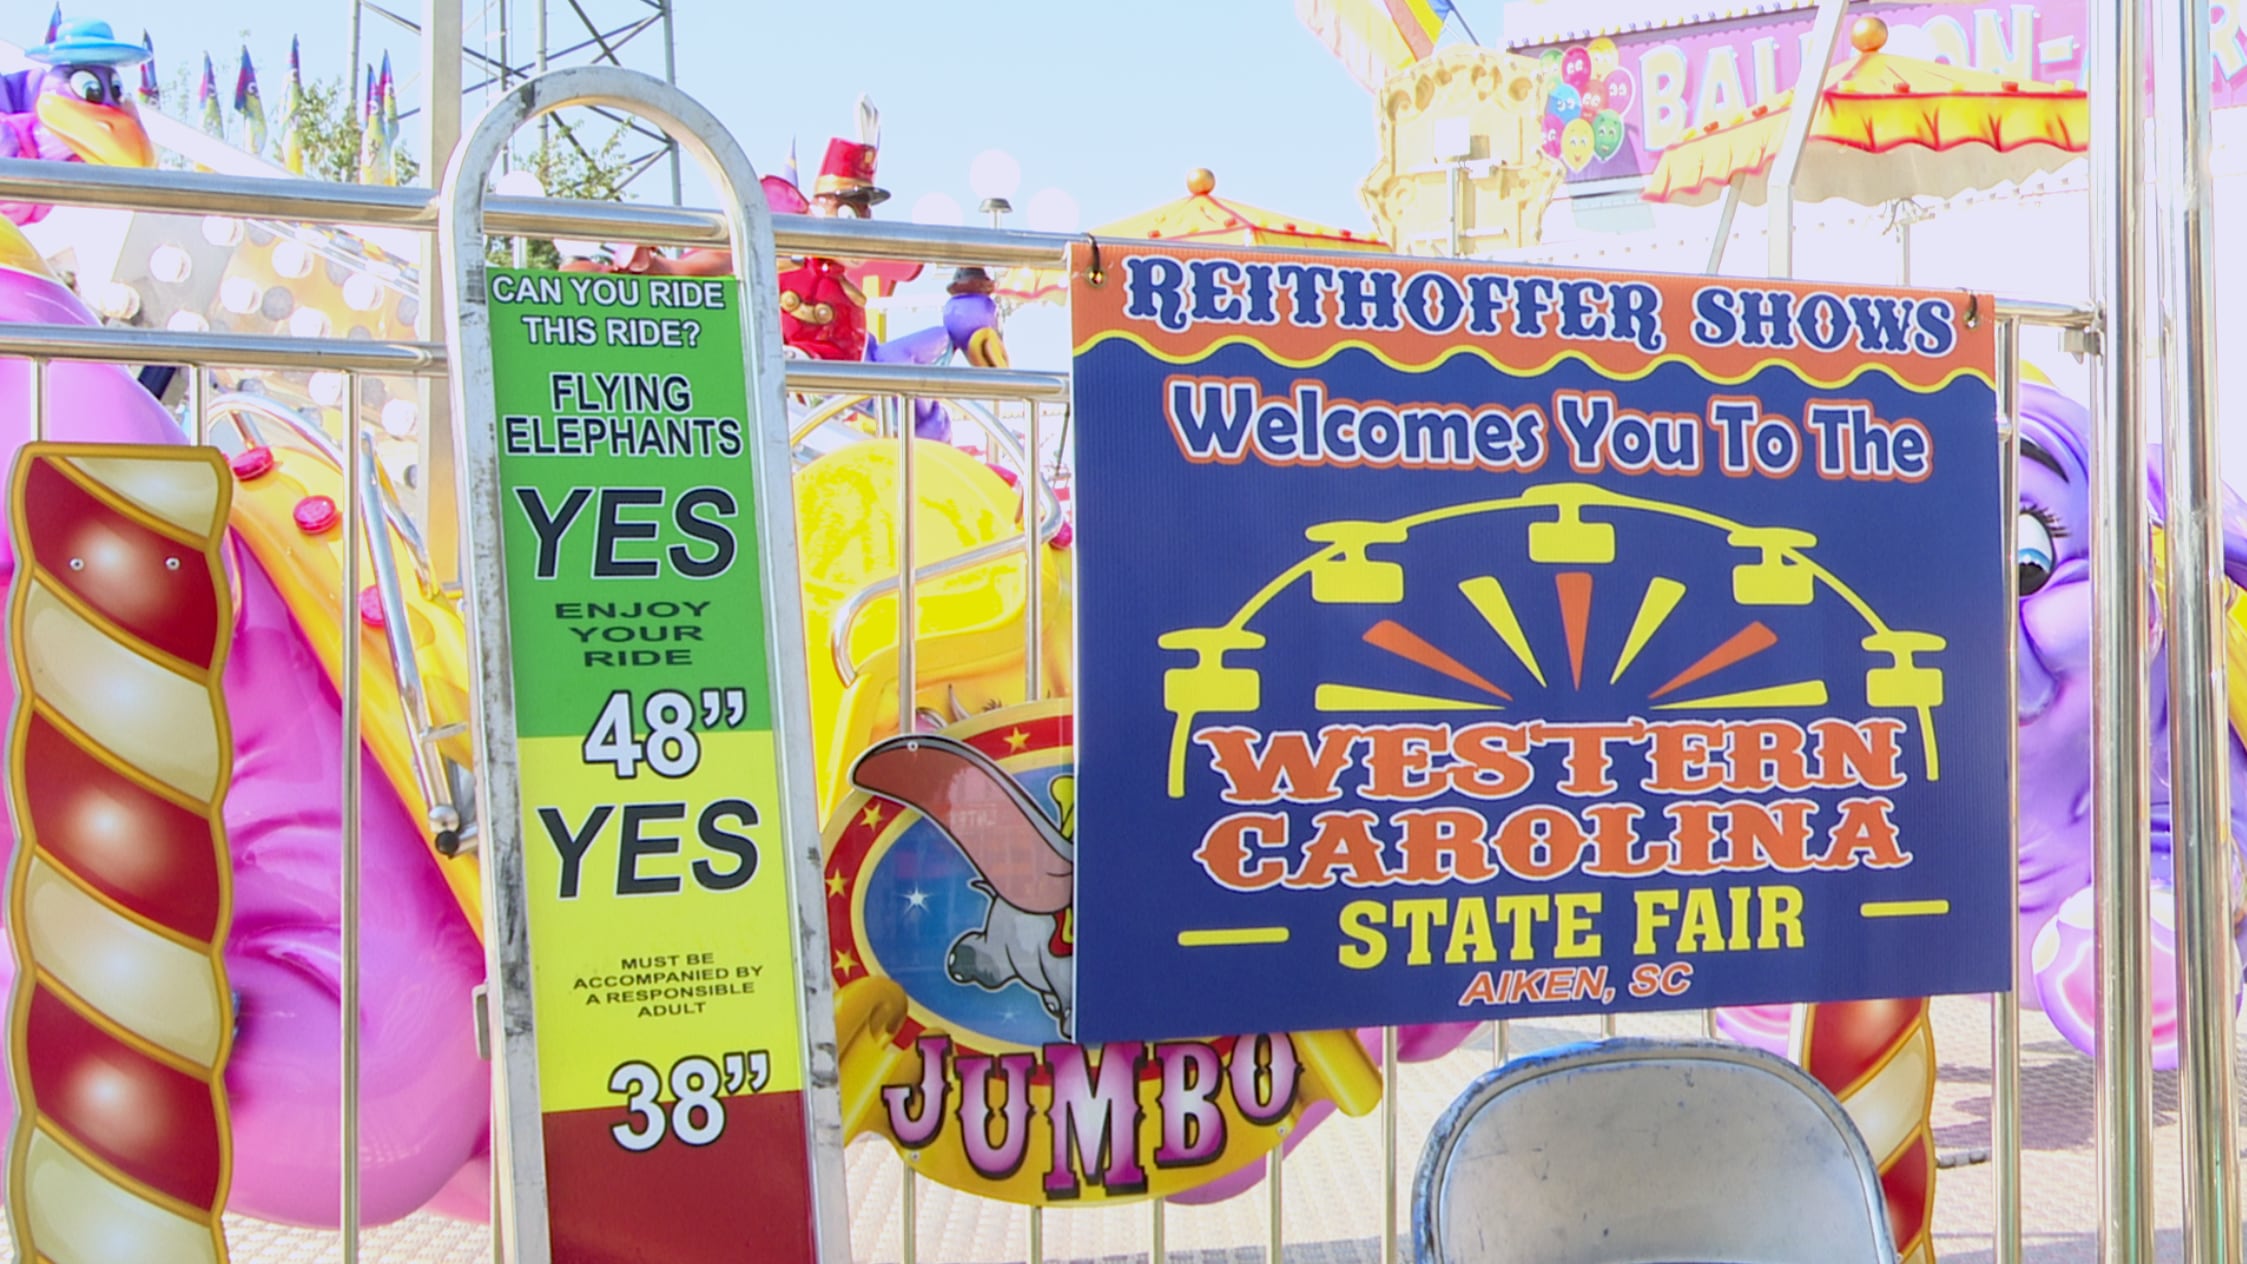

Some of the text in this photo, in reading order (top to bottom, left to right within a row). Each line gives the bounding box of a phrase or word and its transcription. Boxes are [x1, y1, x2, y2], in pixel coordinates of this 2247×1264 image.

[491, 275, 725, 309] CAN YOU RIDE
[1123, 255, 1957, 357] REITHOFFER SHOWS
[521, 315, 701, 348] THIS RIDE?
[550, 371, 692, 413] FLYING
[504, 414, 743, 456] ELEPHANTS
[1162, 373, 1935, 482] Welcomes You To The
[512, 485, 738, 579] YES
[555, 601, 711, 620] ENJOY
[569, 624, 704, 643] YOUR
[583, 649, 694, 668] RIDE
[1192, 715, 1906, 804] WESTERN
[536, 798, 760, 898] YES
[1192, 796, 1914, 892] CAROLINA
[1338, 885, 1805, 970] STATE FAIR
[573, 965, 763, 990] ACCOMPANIED BY
[621, 953, 713, 969] MUST BE
[586, 982, 754, 1005] A RESPONSIBLE
[1457, 961, 1694, 1006] AIKEN, SC
[637, 1003, 705, 1017] ADULT
[881, 1032, 1304, 1199] JUMBO
